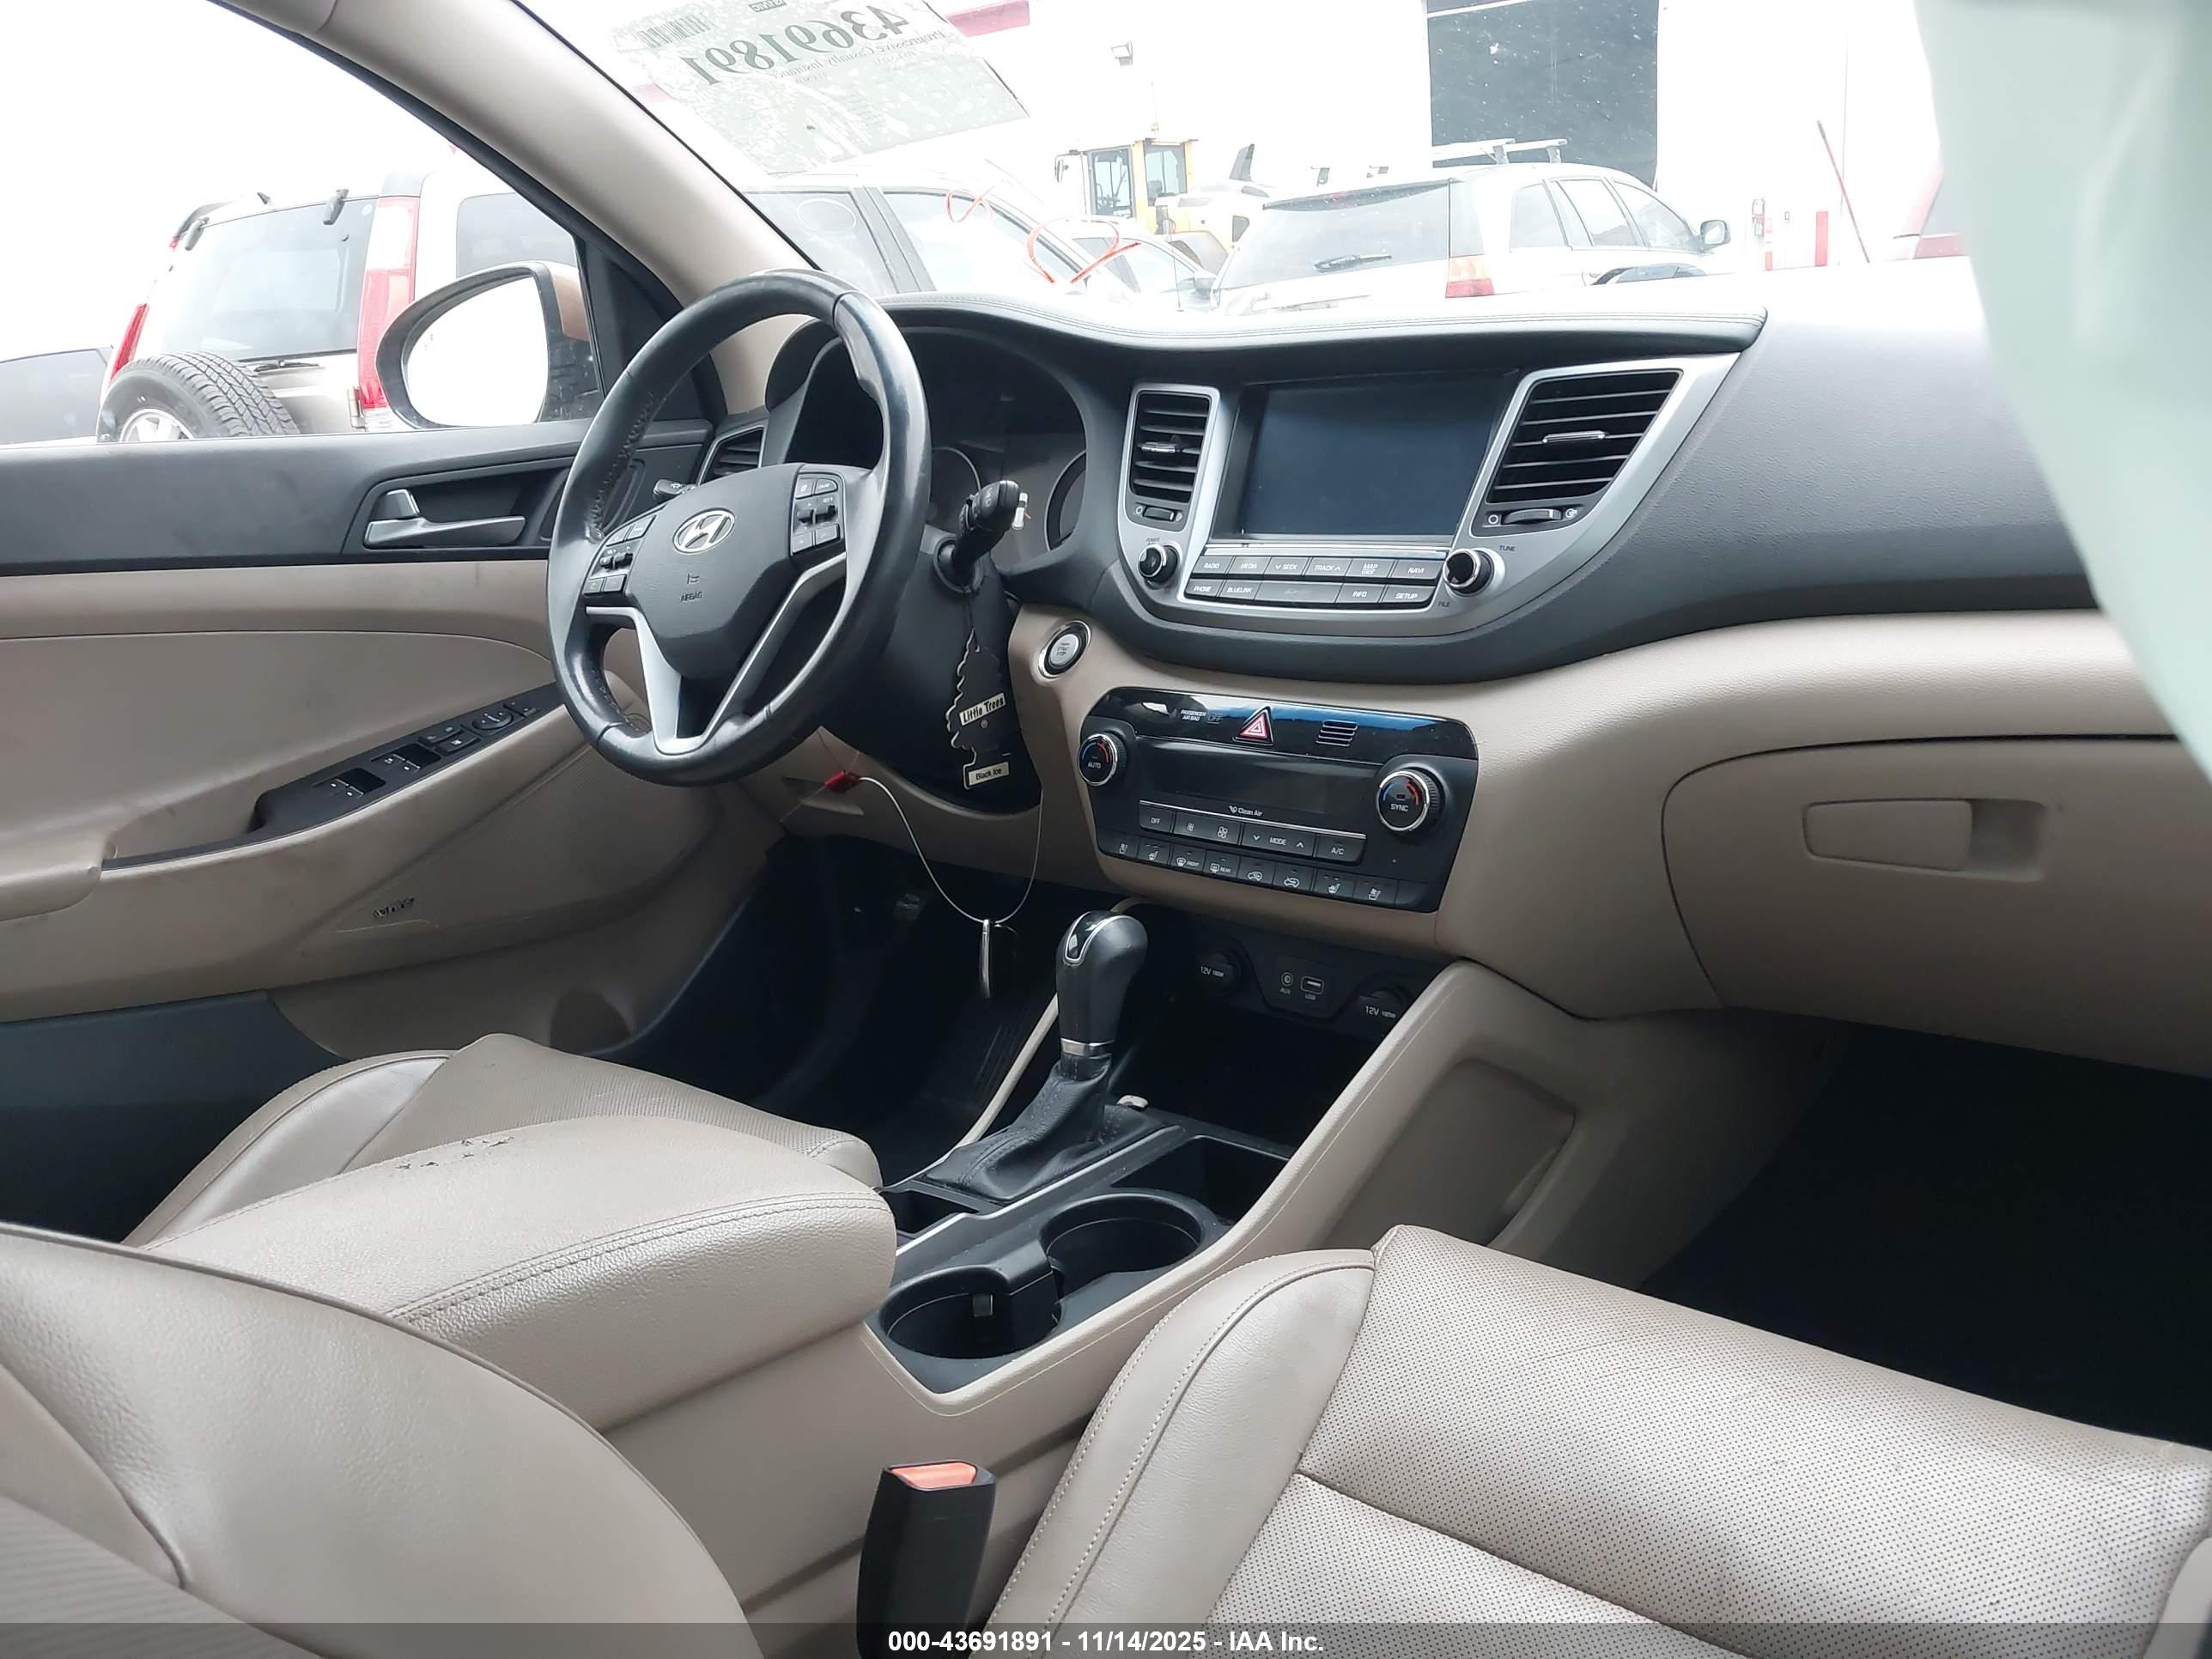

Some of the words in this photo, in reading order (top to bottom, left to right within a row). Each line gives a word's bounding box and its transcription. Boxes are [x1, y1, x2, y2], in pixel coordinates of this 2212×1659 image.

[963, 707, 983, 723] Little
[984, 696, 1005, 712] Trees
[1087, 760, 1101, 769] AUTO
[975, 770, 991, 780] Black
[1237, 806, 1253, 815] Clean
[1390, 802, 1408, 811] SYNC
[1151, 816, 1162, 824] OFF
[1269, 836, 1286, 846] MODE
[1331, 846, 1345, 855] A/C
[1200, 966, 1212, 975] 12V
[1365, 1005, 1380, 1017] 12V
